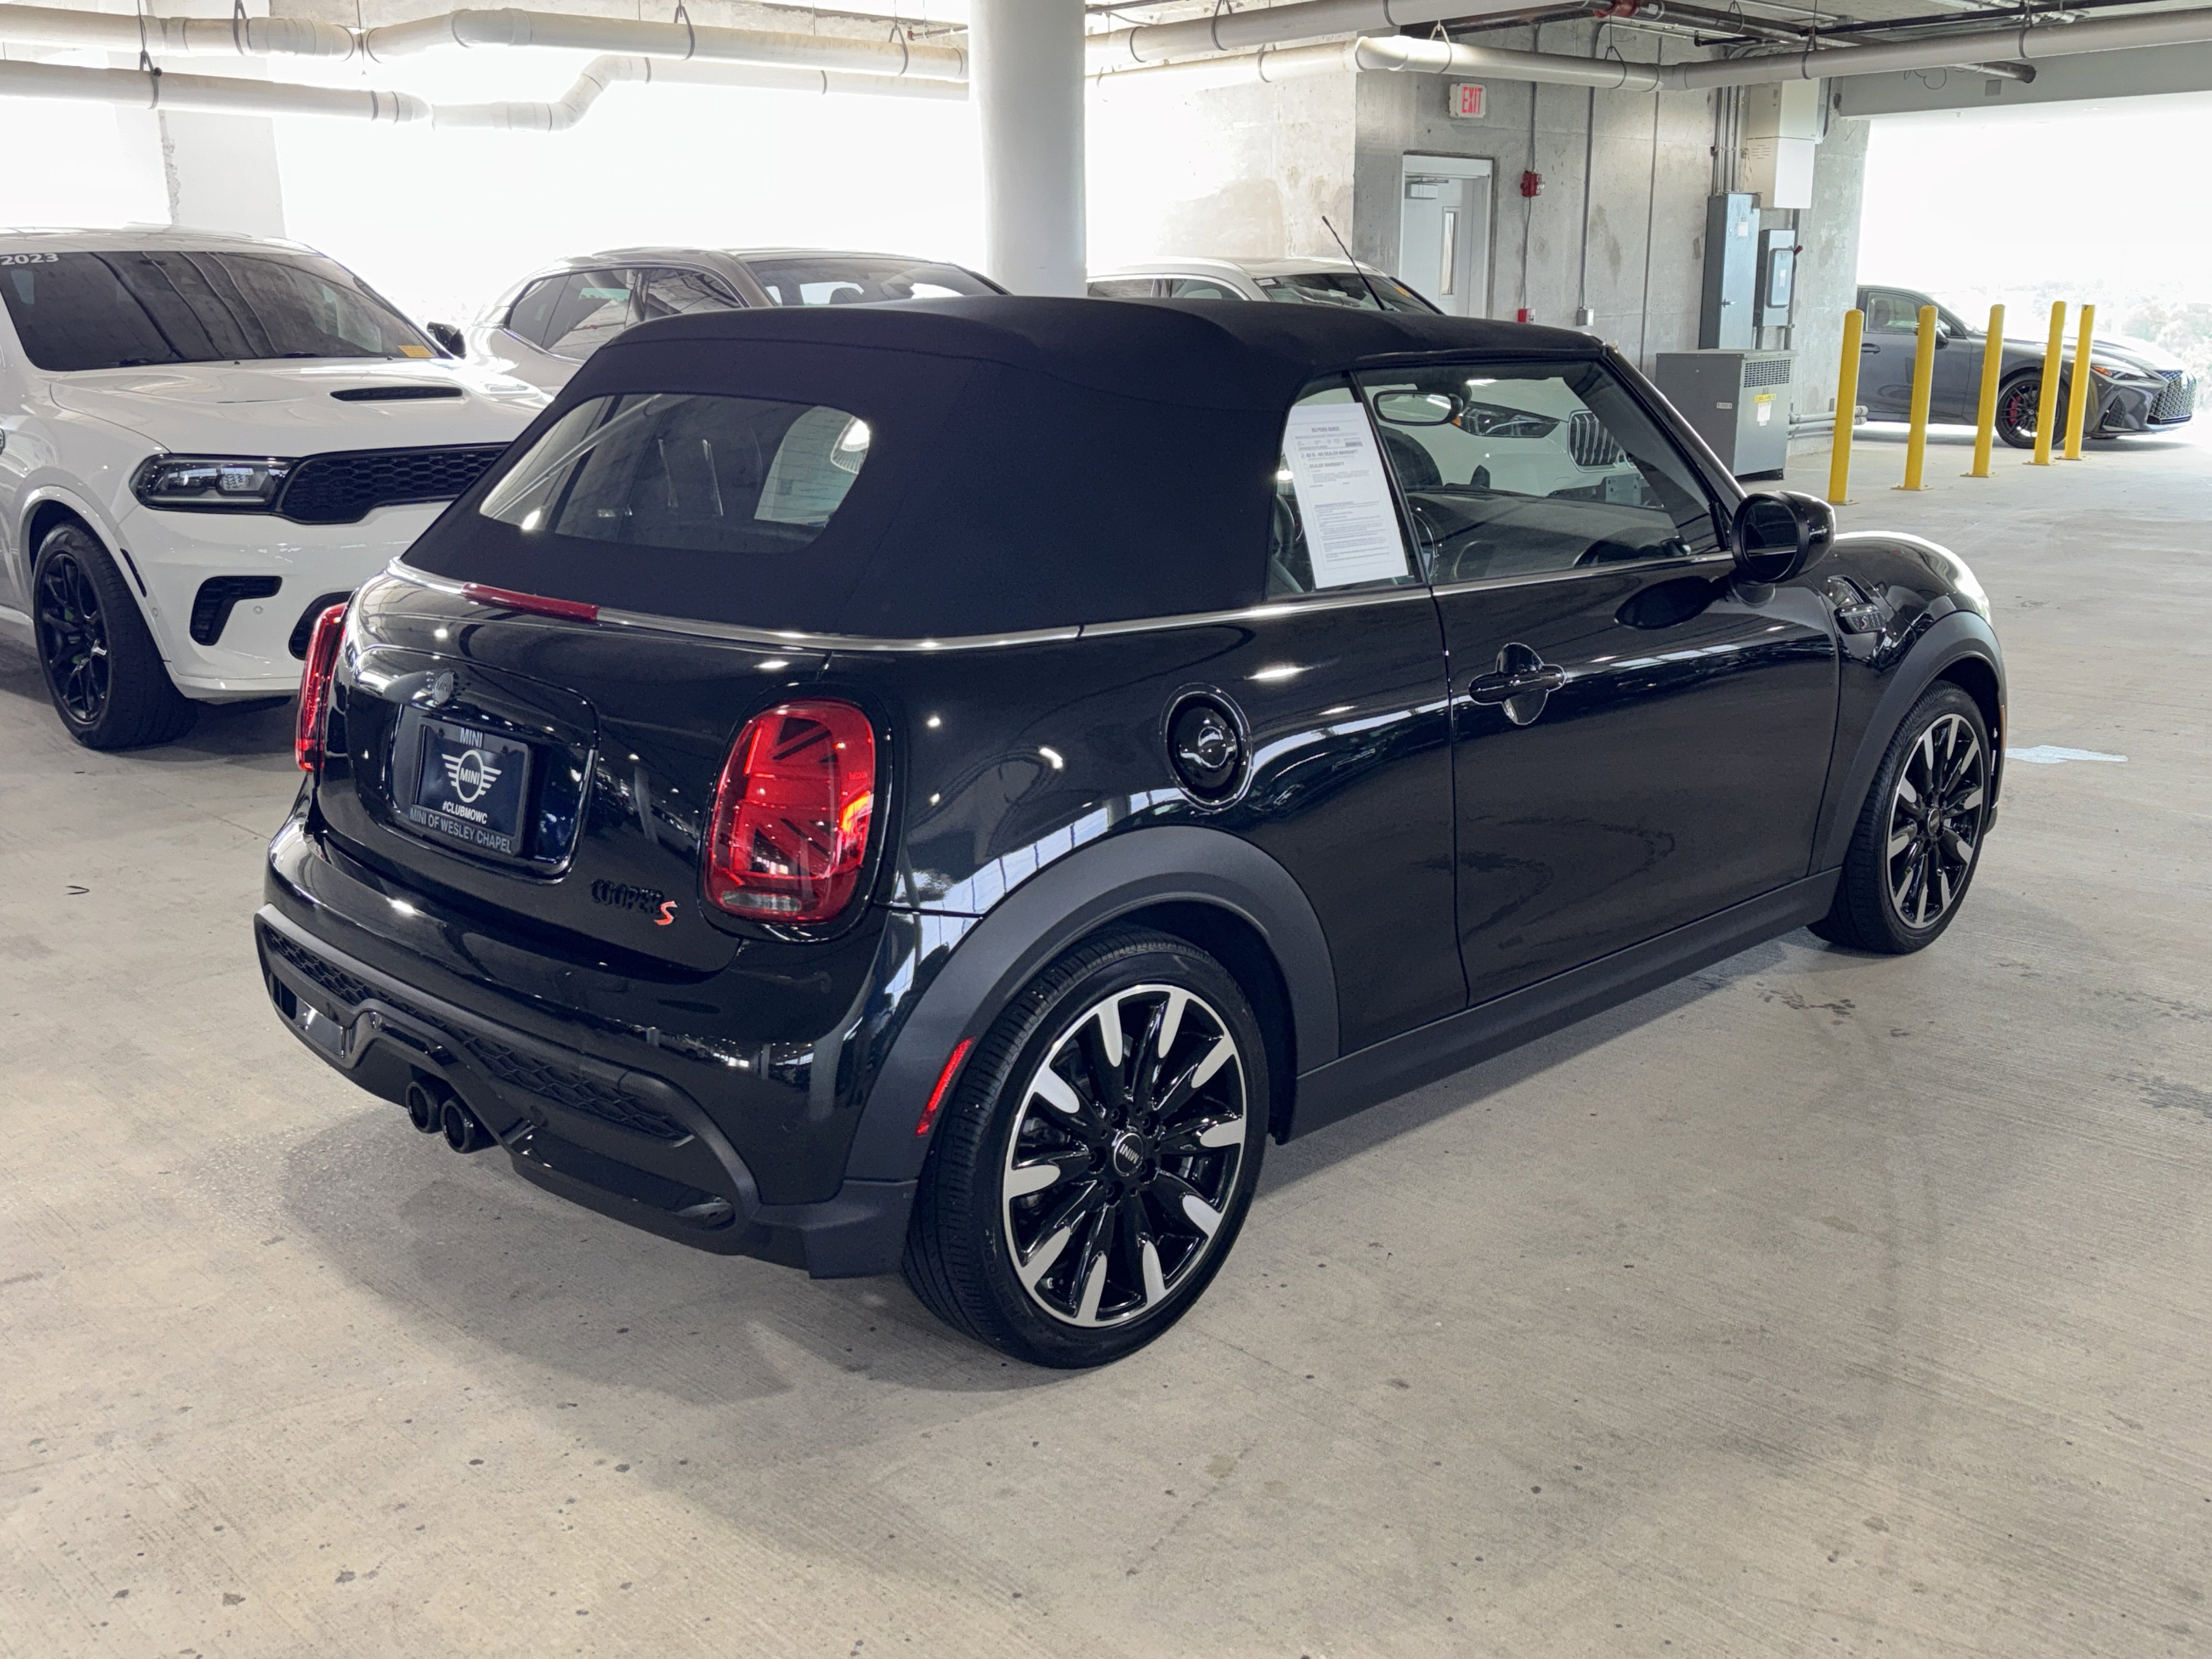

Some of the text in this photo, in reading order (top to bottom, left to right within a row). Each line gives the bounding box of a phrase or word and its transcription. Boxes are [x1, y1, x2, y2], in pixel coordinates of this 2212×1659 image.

[1462, 87, 1483, 114] EXIT
[0, 253, 59, 266] 2023
[460, 727, 483, 748] MINI
[459, 767, 481, 785] MINI
[442, 800, 488, 825] #CLUBMOWC
[409, 807, 512, 854] MINI OF WESLEY CHAPEL
[654, 900, 678, 926] S
[1119, 1143, 1139, 1164] MINI
